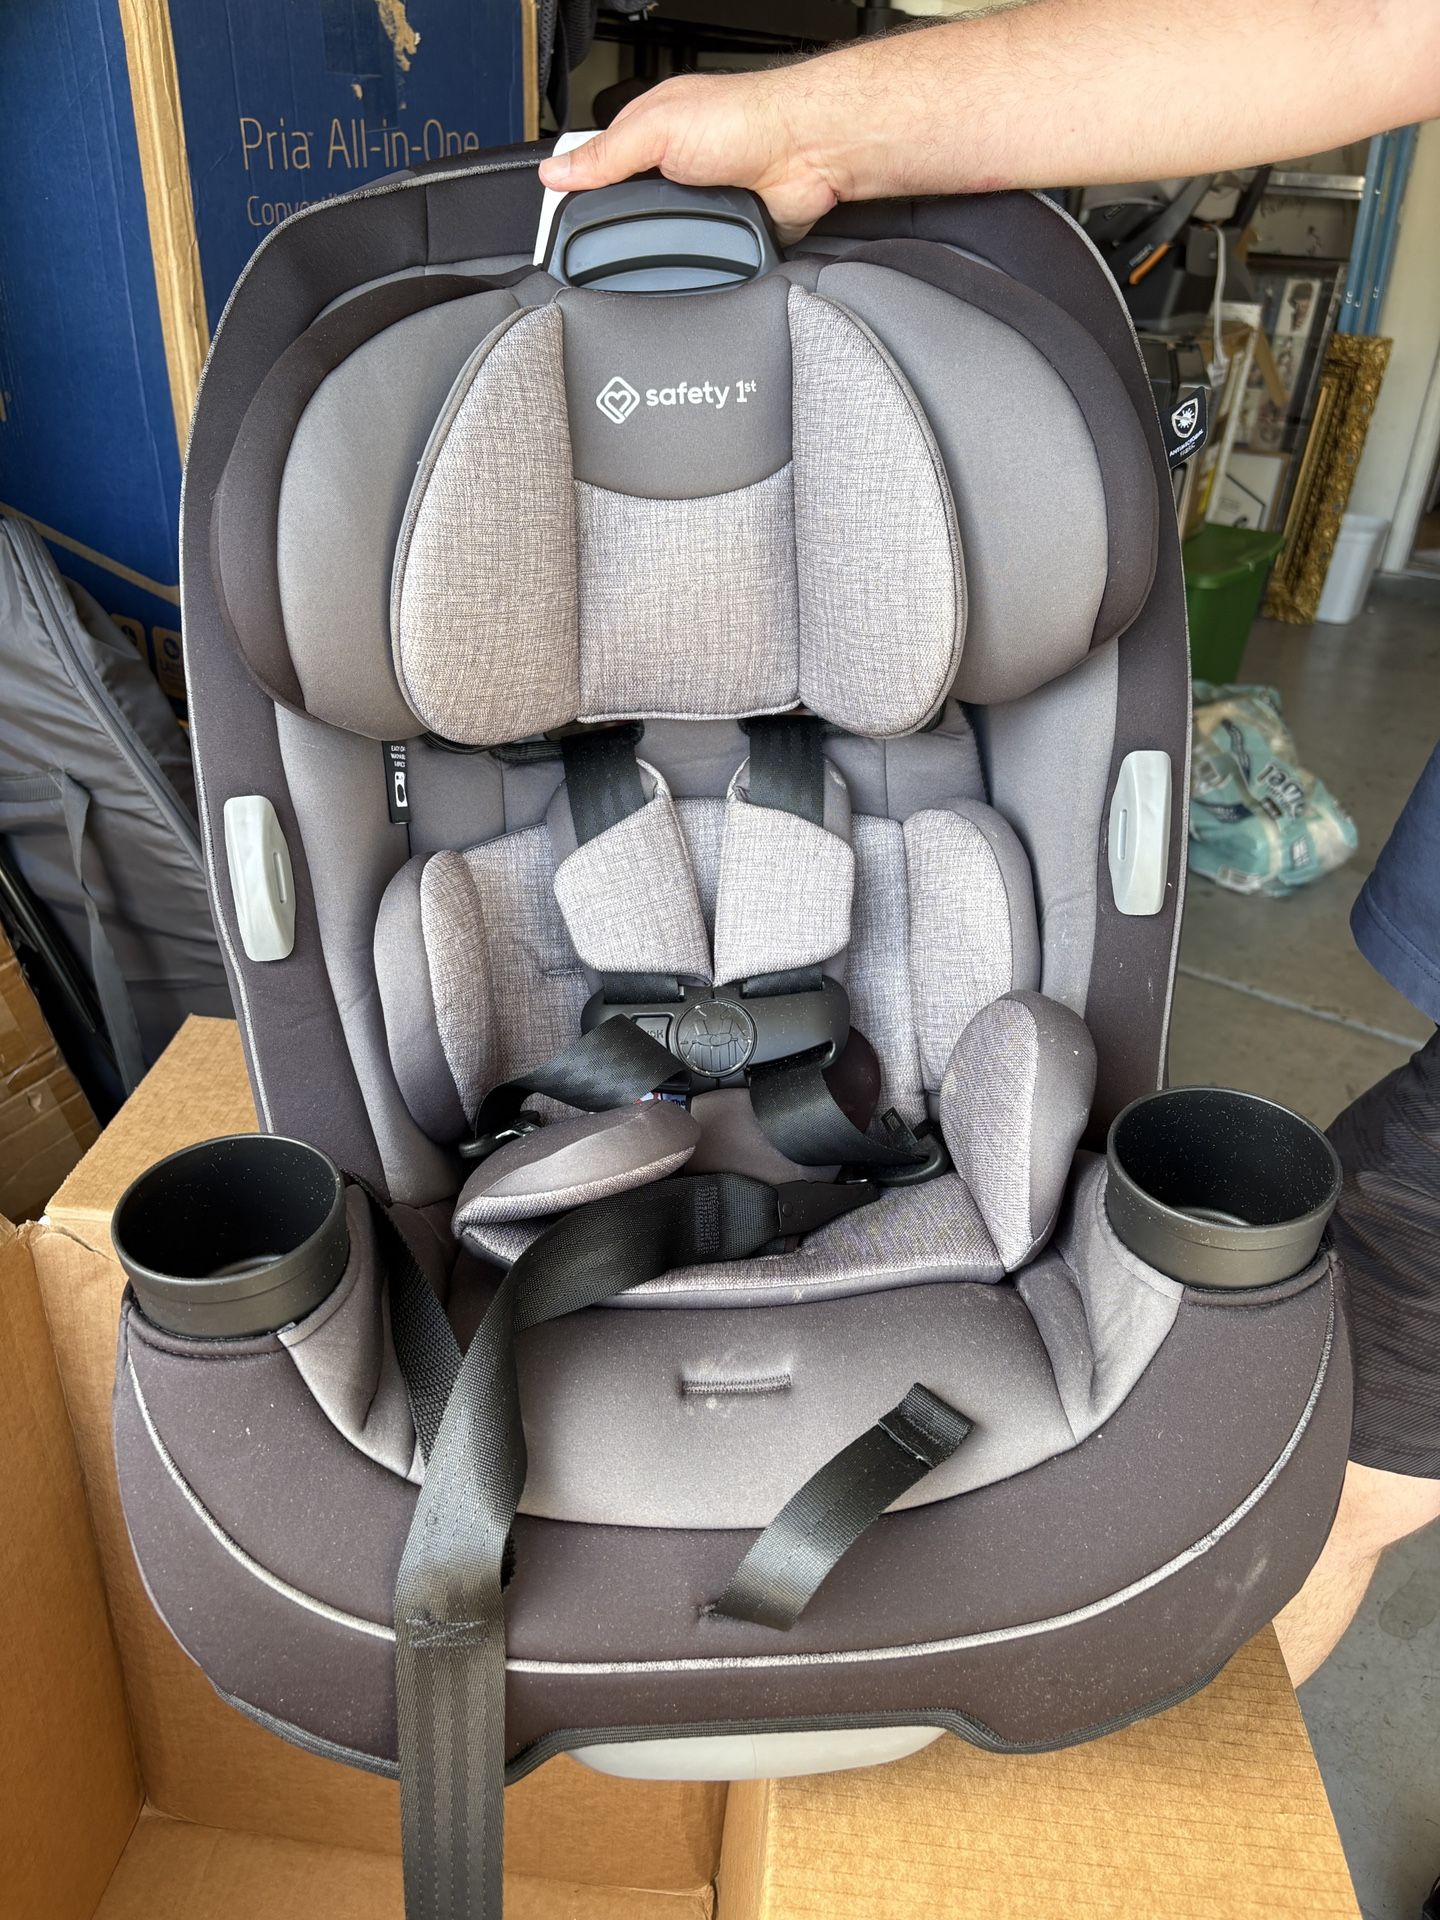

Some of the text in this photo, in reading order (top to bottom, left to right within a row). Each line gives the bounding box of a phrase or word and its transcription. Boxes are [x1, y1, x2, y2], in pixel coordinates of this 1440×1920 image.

[327, 118, 480, 168] All-in-One
[645, 380, 757, 409] safety 1st
